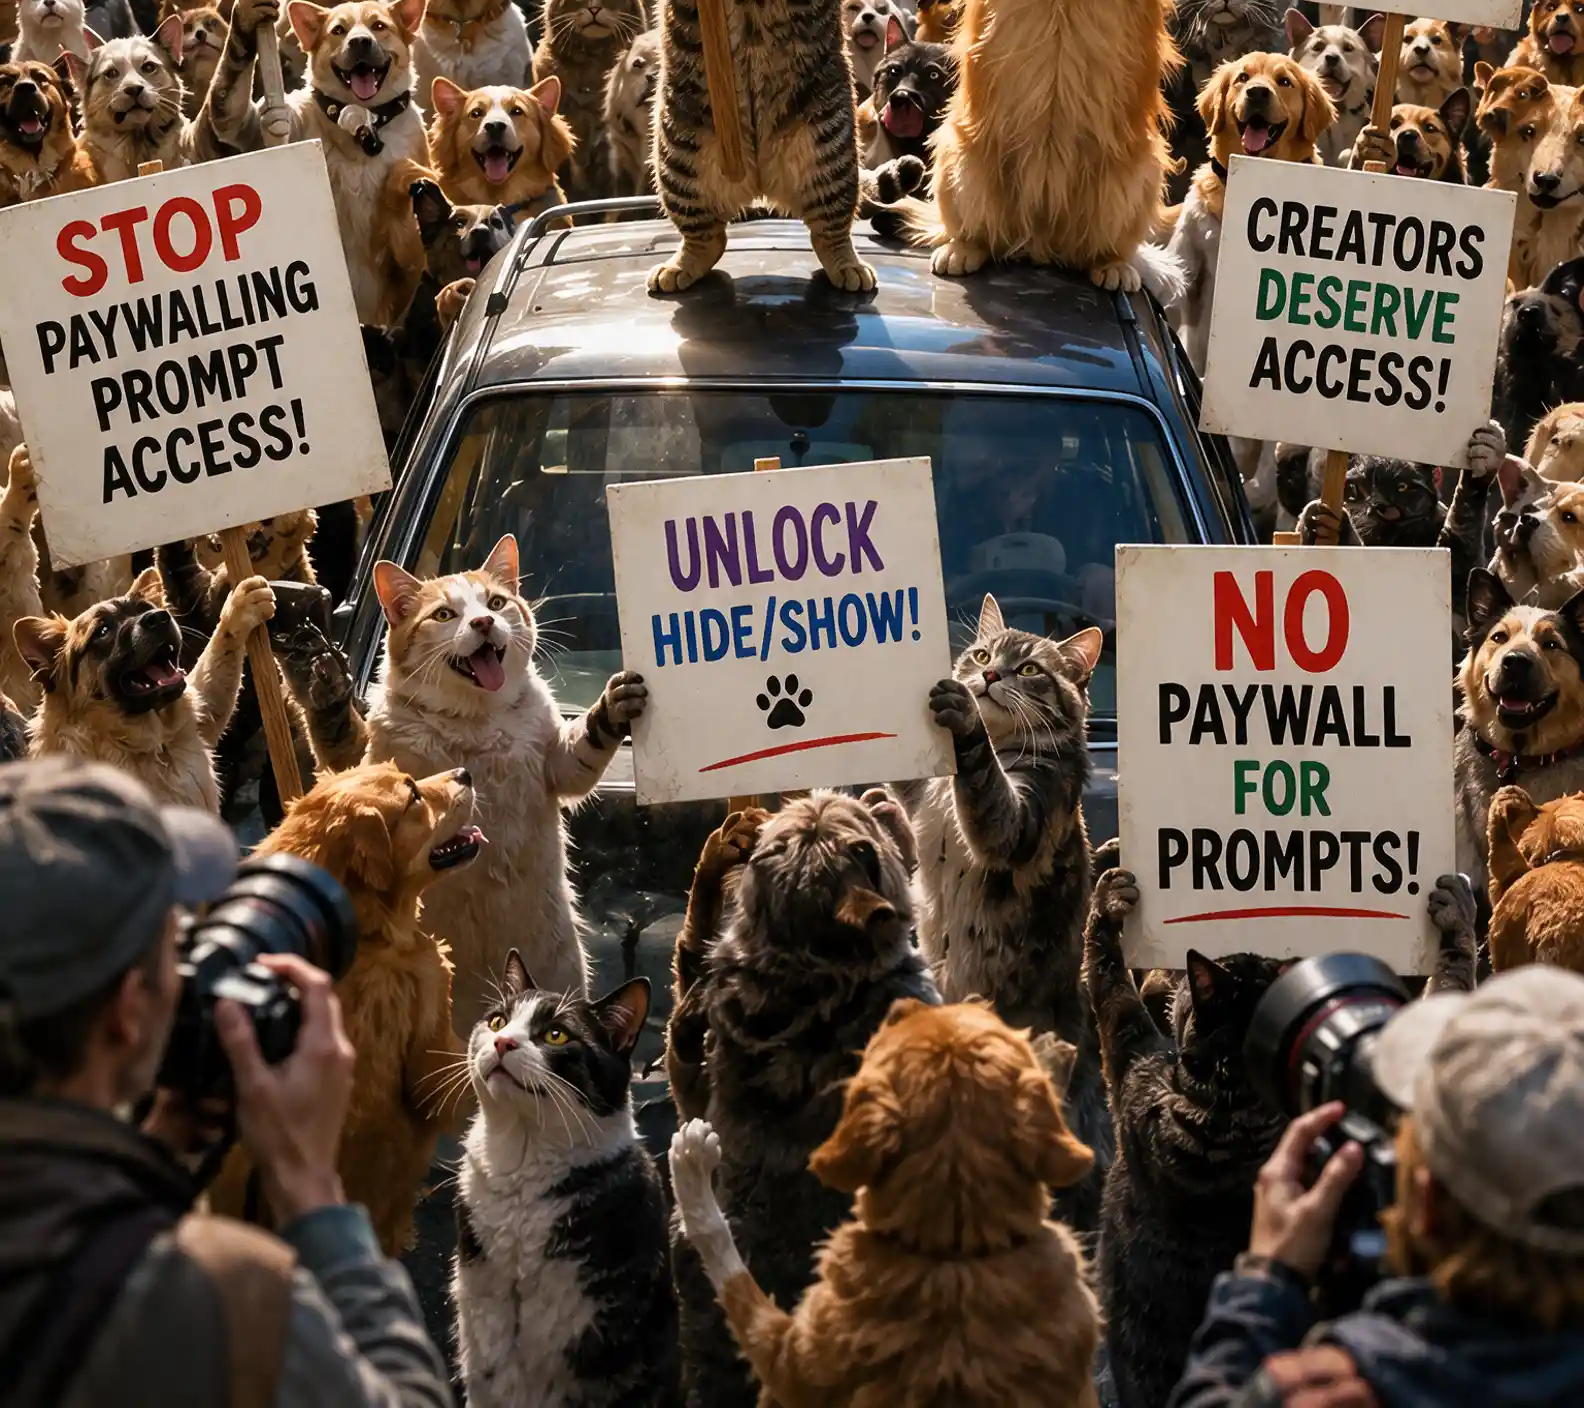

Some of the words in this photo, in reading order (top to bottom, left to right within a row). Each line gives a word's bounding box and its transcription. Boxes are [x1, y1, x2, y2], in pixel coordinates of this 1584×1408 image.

[57, 184, 261, 297] STOP
[1247, 197, 1485, 280] CREATORS
[36, 261, 319, 374] PAYWALLING
[1256, 268, 1460, 344] DESERVE
[91, 335, 284, 432] PROMPT
[1249, 337, 1451, 413] ACCESS!
[103, 398, 310, 504] ACCESS!
[665, 500, 884, 592] UNLOCK
[652, 587, 921, 667] HIDE/SHOW!
[1214, 570, 1349, 673] NO
[1159, 683, 1411, 747] PAYWALL
[1234, 760, 1331, 816] FOR
[1158, 828, 1420, 895] PROMPTS!
